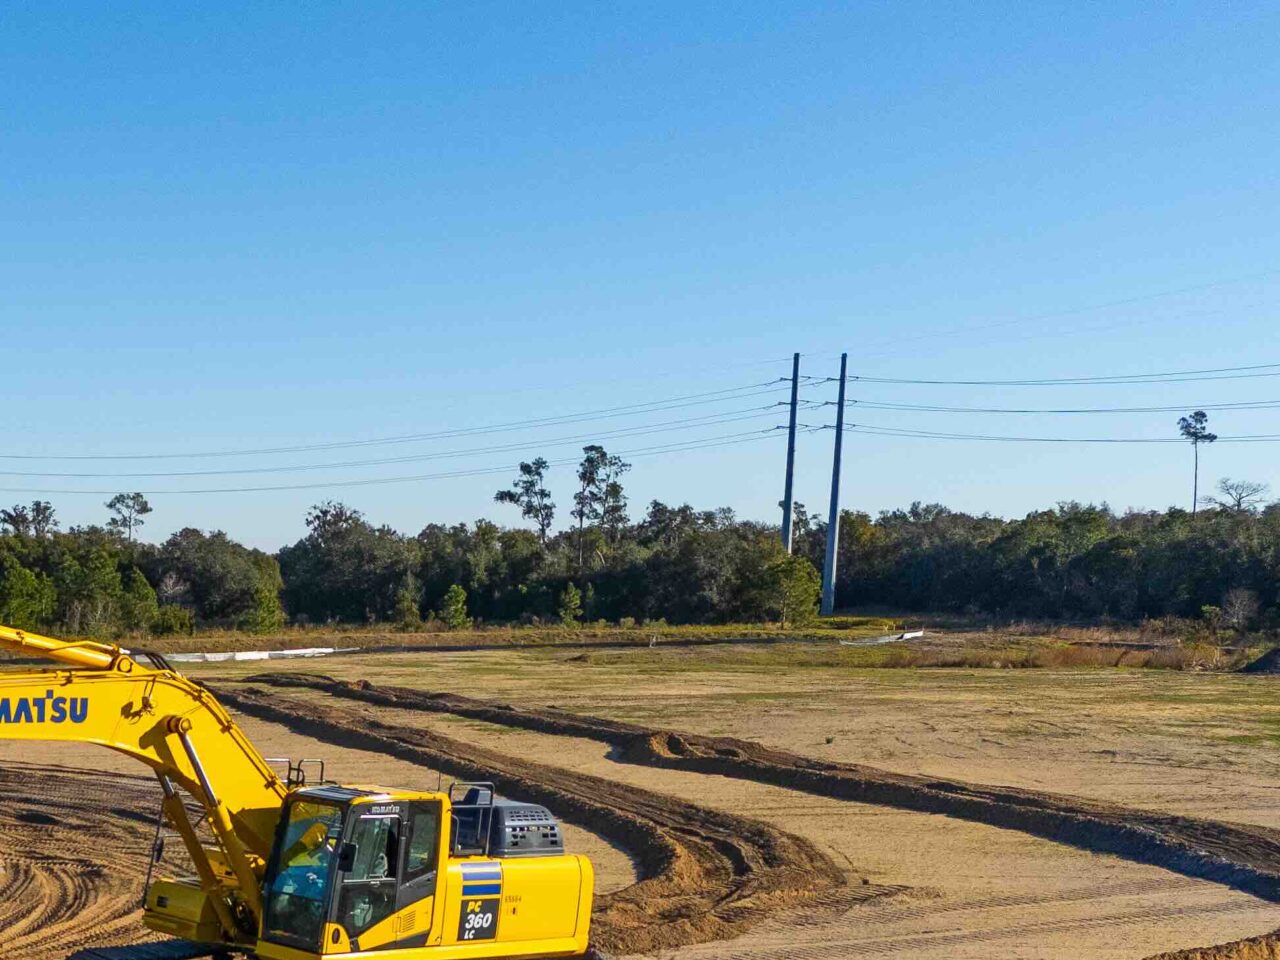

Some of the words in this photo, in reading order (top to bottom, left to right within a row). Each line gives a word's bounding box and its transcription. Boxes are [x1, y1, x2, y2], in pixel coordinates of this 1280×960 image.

[467, 901, 482, 913] PC
[465, 913, 492, 929] 360
[464, 930, 476, 939] LC
